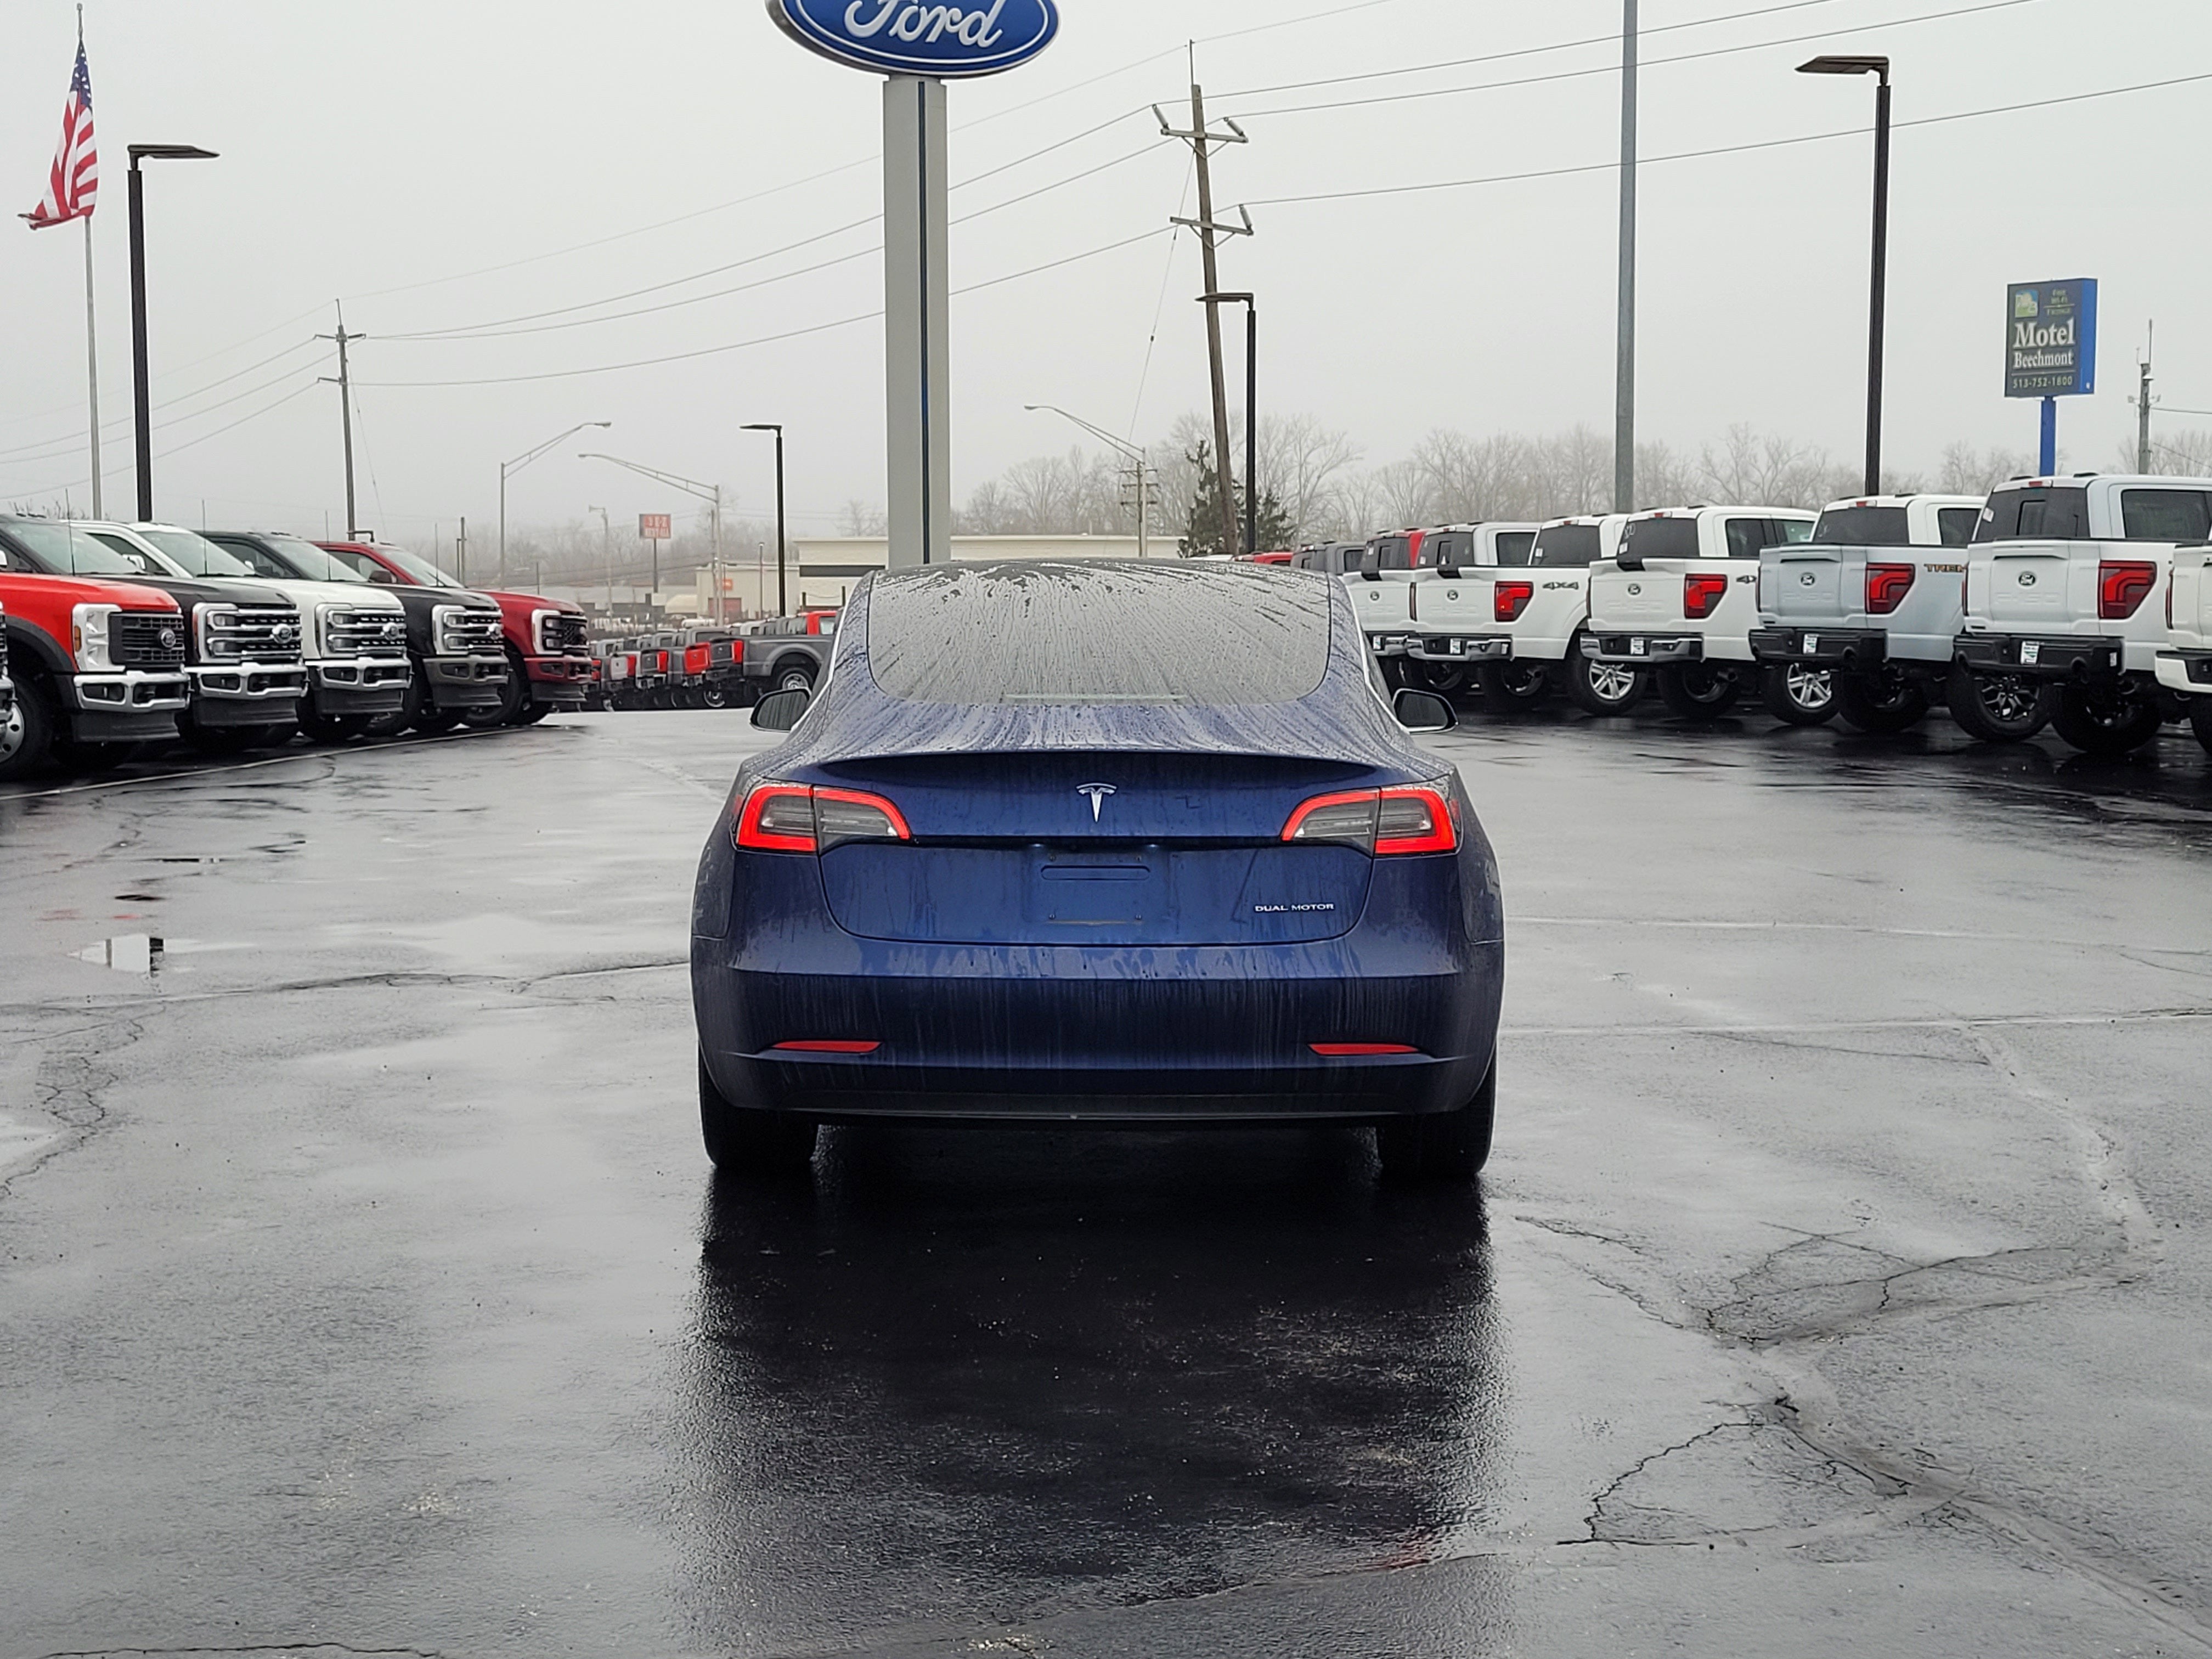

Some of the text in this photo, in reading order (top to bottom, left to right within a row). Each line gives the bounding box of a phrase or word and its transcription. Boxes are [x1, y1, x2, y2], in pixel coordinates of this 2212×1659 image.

[844, 0, 1003, 48] Ford
[2013, 318, 2075, 348] Motel
[2015, 349, 2073, 368] Beechmont
[1291, 903, 1335, 911] MOTOR
